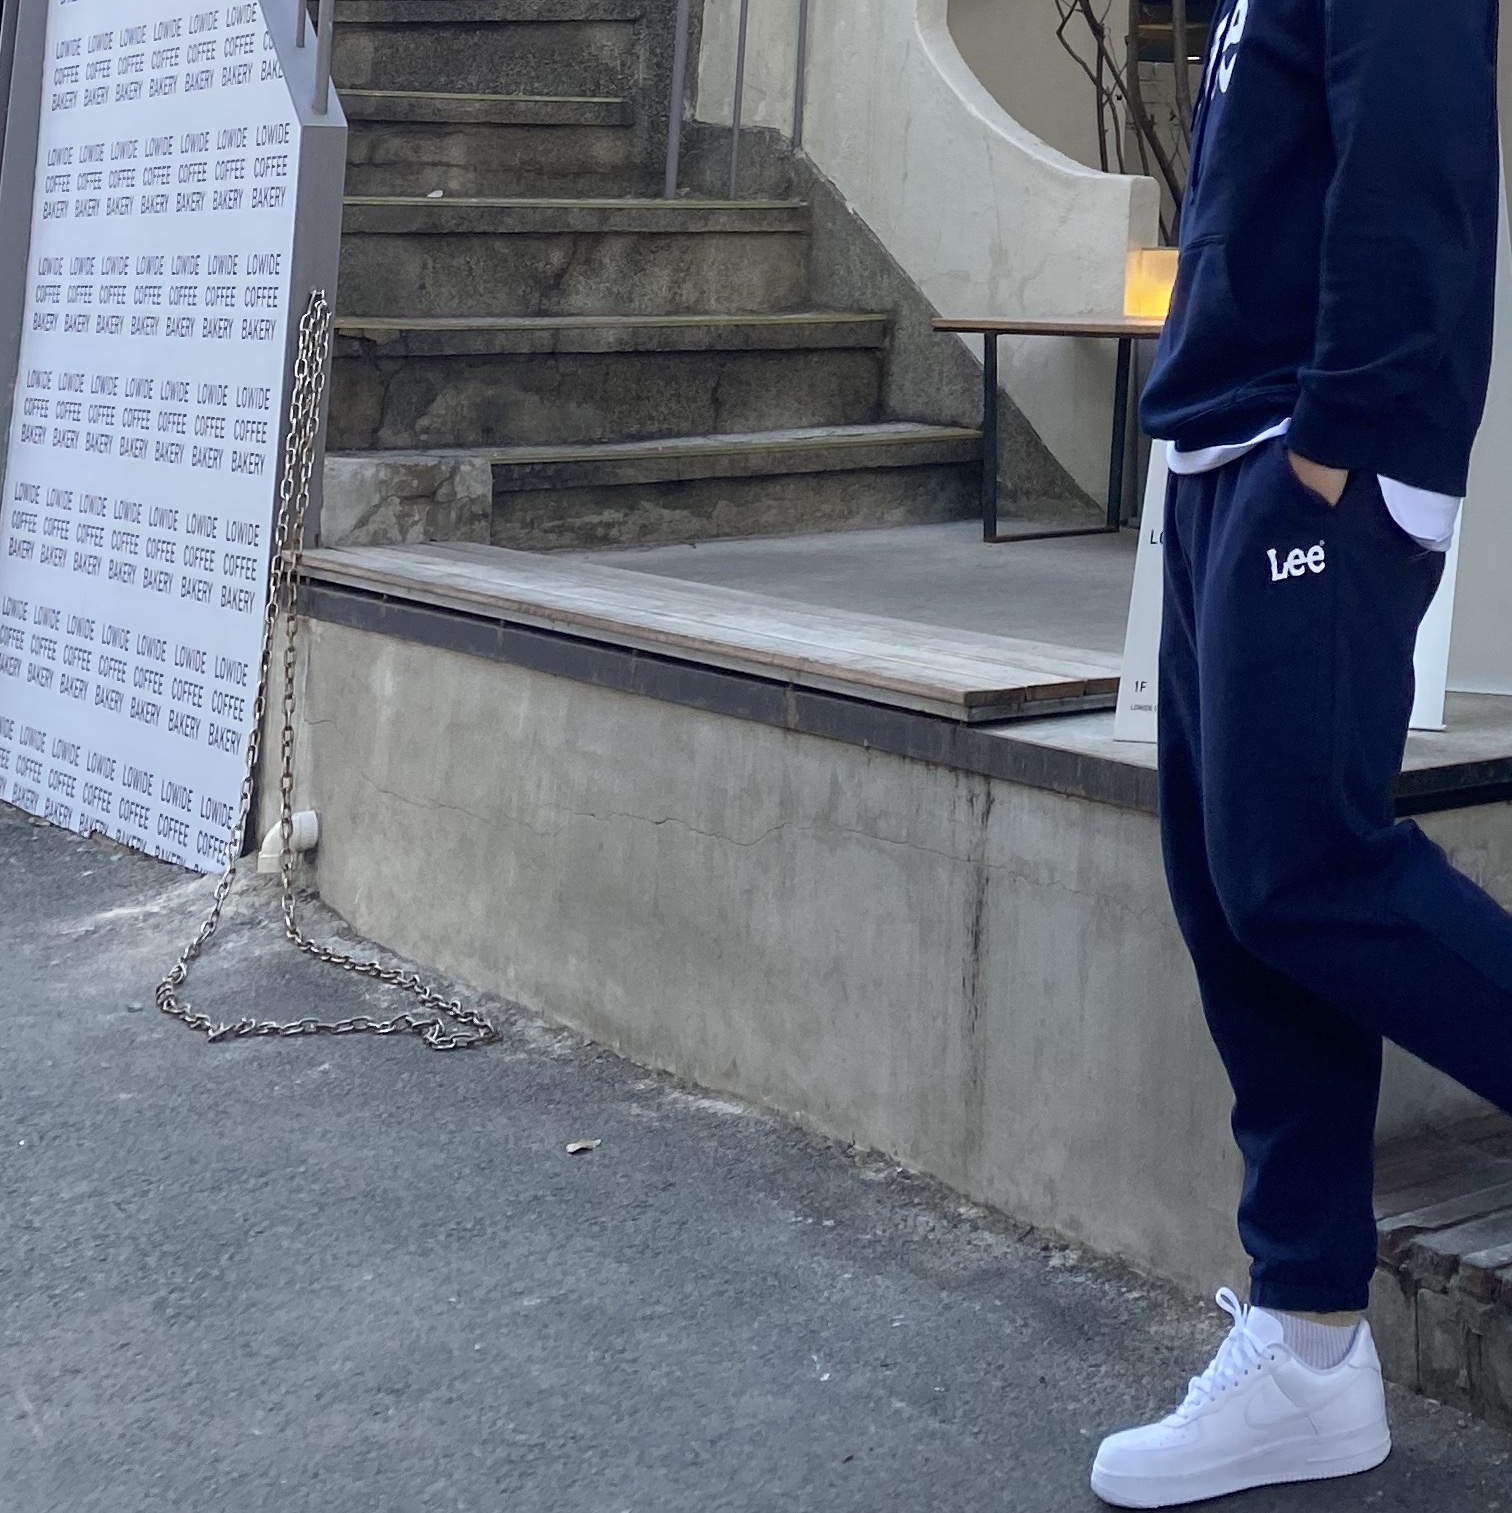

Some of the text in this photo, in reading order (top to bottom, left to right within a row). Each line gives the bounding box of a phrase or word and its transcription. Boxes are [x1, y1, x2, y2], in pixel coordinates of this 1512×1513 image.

[188, 9, 218, 34] LOWIDE
[225, 2, 256, 27] LOWIDE
[186, 39, 216, 63] COFFEE
[223, 32, 254, 57] COFFEE
[184, 68, 214, 92] BAKERY
[221, 62, 252, 86] BAKERY
[180, 131, 209, 153] LOWIDE
[216, 126, 247, 149] LOWIDE
[255, 122, 289, 146] LOWIDE
[177, 161, 207, 183] COFFEE
[214, 158, 245, 180] COFFEE
[253, 154, 287, 178] COFFEE
[175, 191, 205, 212] BAKERY
[212, 188, 243, 210] BAKERY
[251, 185, 285, 208] BAKERY
[171, 254, 200, 275] LOWIDE
[207, 254, 238, 275] LOWIDE
[246, 253, 281, 275] LOWIDE
[168, 285, 197, 306] COFFEE
[204, 285, 236, 307] COFFEE
[244, 286, 278, 307] COFFEE
[165, 316, 195, 337] BAKERY
[202, 317, 233, 338] BAKERY
[241, 318, 276, 340] BAKERY
[160, 380, 189, 402] LOWIDE
[196, 383, 228, 406] LOWIDE
[235, 386, 270, 409] LOWIDE
[157, 411, 186, 434] COFFEE
[194, 414, 225, 438] COFFEE
[233, 418, 267, 443] COFFEE
[154, 440, 184, 463] BAKERY
[191, 445, 223, 469] BAKERY
[231, 450, 265, 475] BAKERY
[148, 506, 178, 531] LOWIDE
[185, 513, 217, 538] LOWIDE
[225, 519, 259, 546] LOWIDE
[145, 537, 176, 563] COFFEE
[183, 544, 215, 572] COFFEE
[222, 552, 257, 581] COFFEE
[1266, 544, 1326, 582] Lee
[142, 567, 173, 593] BAKERY
[180, 575, 212, 602] BAKERY
[220, 584, 255, 613] BAKERY
[136, 633, 166, 661] LOWIDE
[174, 644, 206, 673] LOWIDE
[214, 655, 248, 686] LOWIDE
[133, 665, 163, 695] COFFEE
[171, 676, 203, 707] COFFEE
[211, 689, 244, 721] COFFEE
[129, 696, 161, 725] BAKERY
[167, 708, 200, 739] BAKERY
[207, 722, 241, 754] BAKERY
[122, 764, 153, 796] LOWIDE
[160, 779, 193, 812] LOWIDE
[200, 795, 234, 830] LOWIDE
[118, 796, 150, 829] COFFEE
[157, 812, 189, 847] COFFEE
